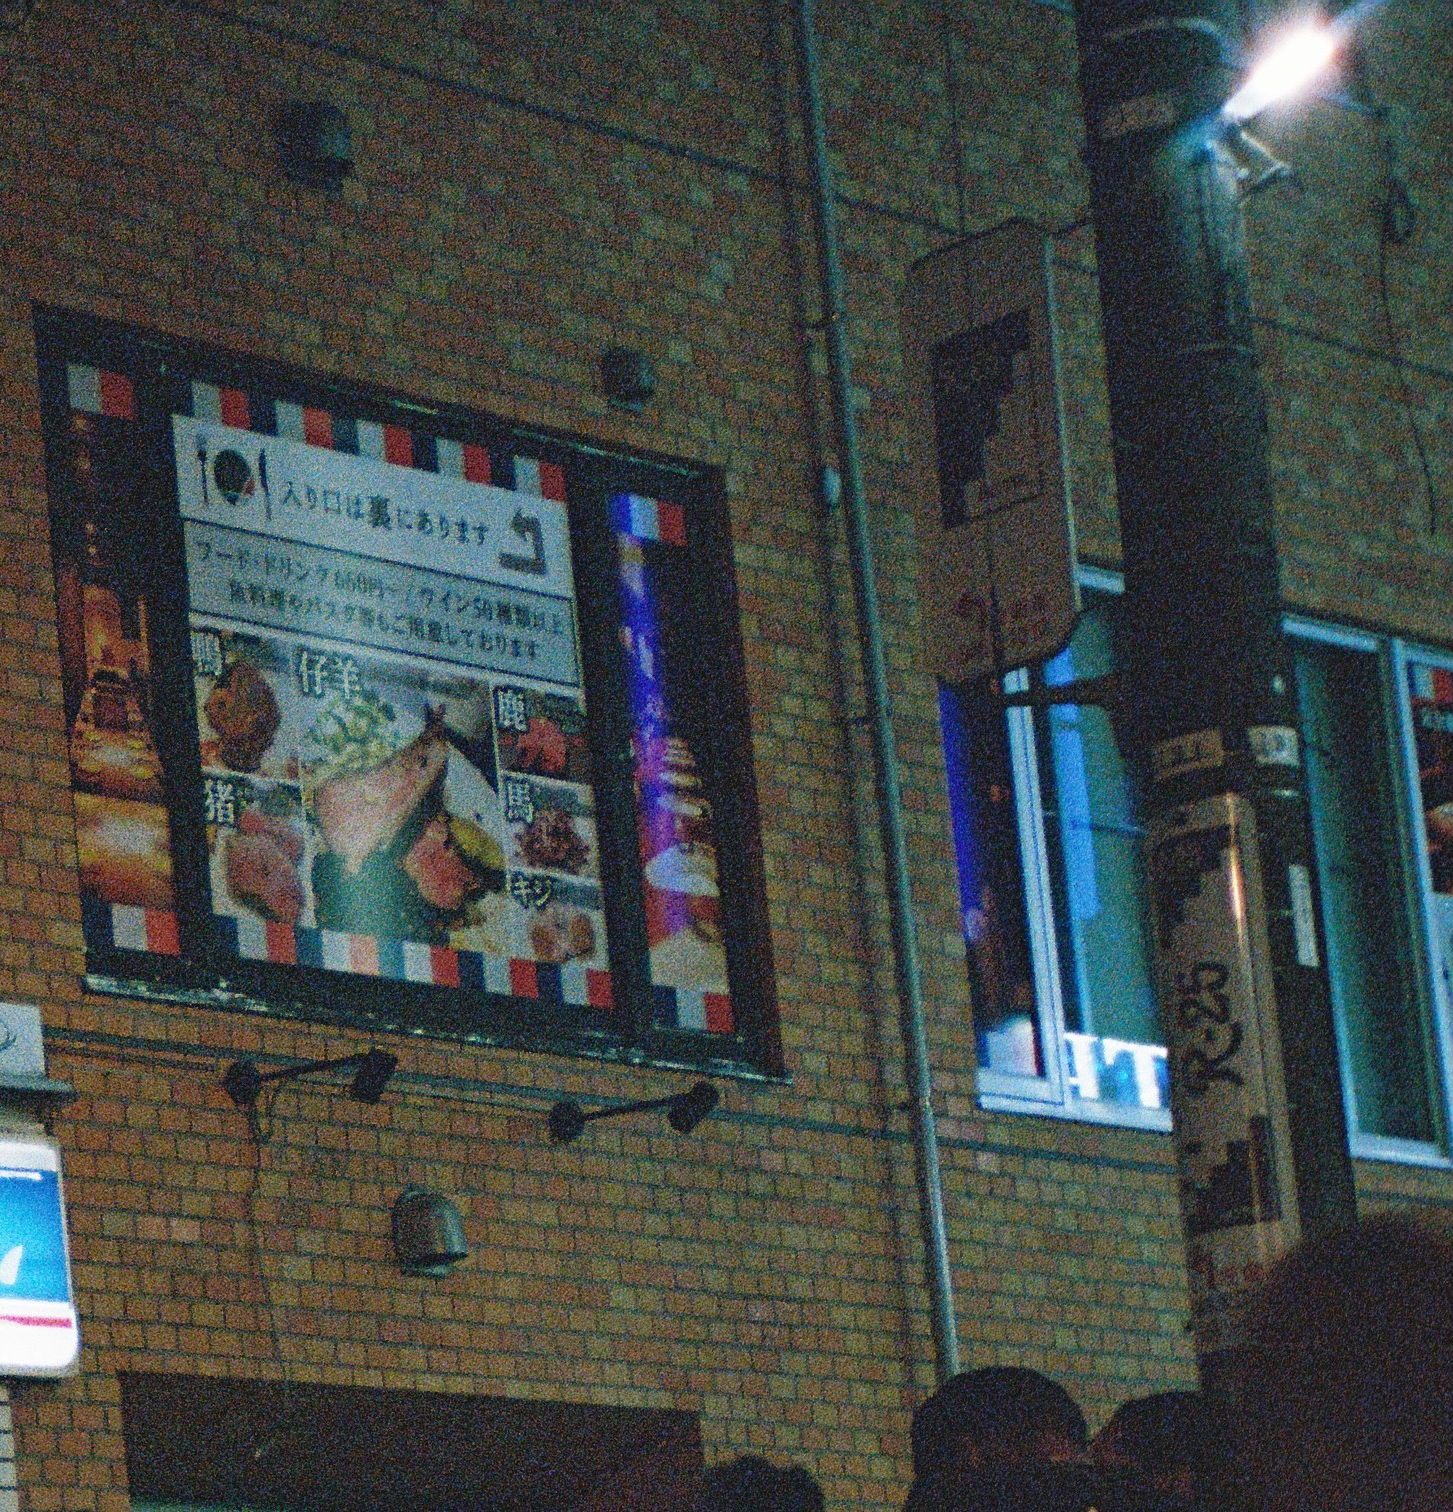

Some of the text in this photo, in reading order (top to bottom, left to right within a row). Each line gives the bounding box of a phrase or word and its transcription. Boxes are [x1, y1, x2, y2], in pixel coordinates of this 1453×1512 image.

[281, 481, 489, 545] 入り口は裏にあります
[298, 646, 365, 700] 仔羊
[511, 873, 554, 908] キジ
